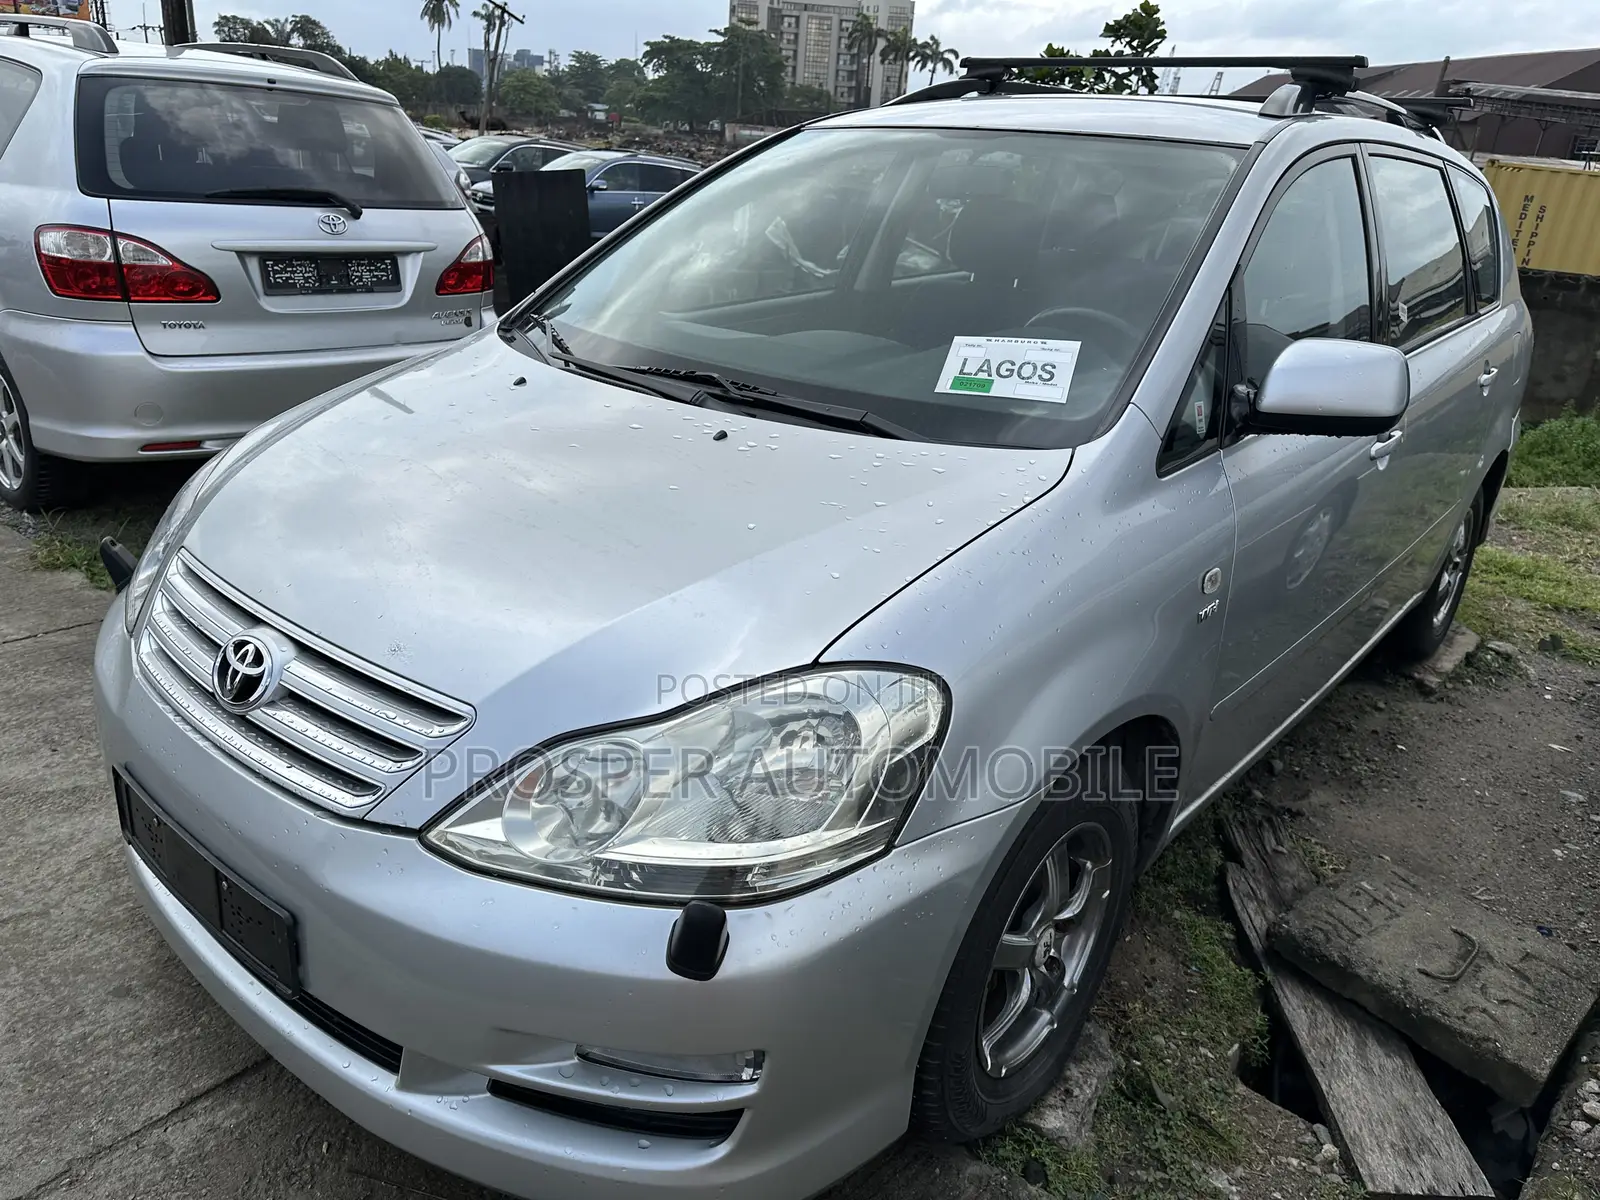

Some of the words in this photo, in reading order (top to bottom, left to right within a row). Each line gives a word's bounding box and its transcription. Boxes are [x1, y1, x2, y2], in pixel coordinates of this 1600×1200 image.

[160, 320, 206, 330] TOYOTA
[958, 358, 1057, 382] LAGOS
[959, 381, 986, 389] 021709
